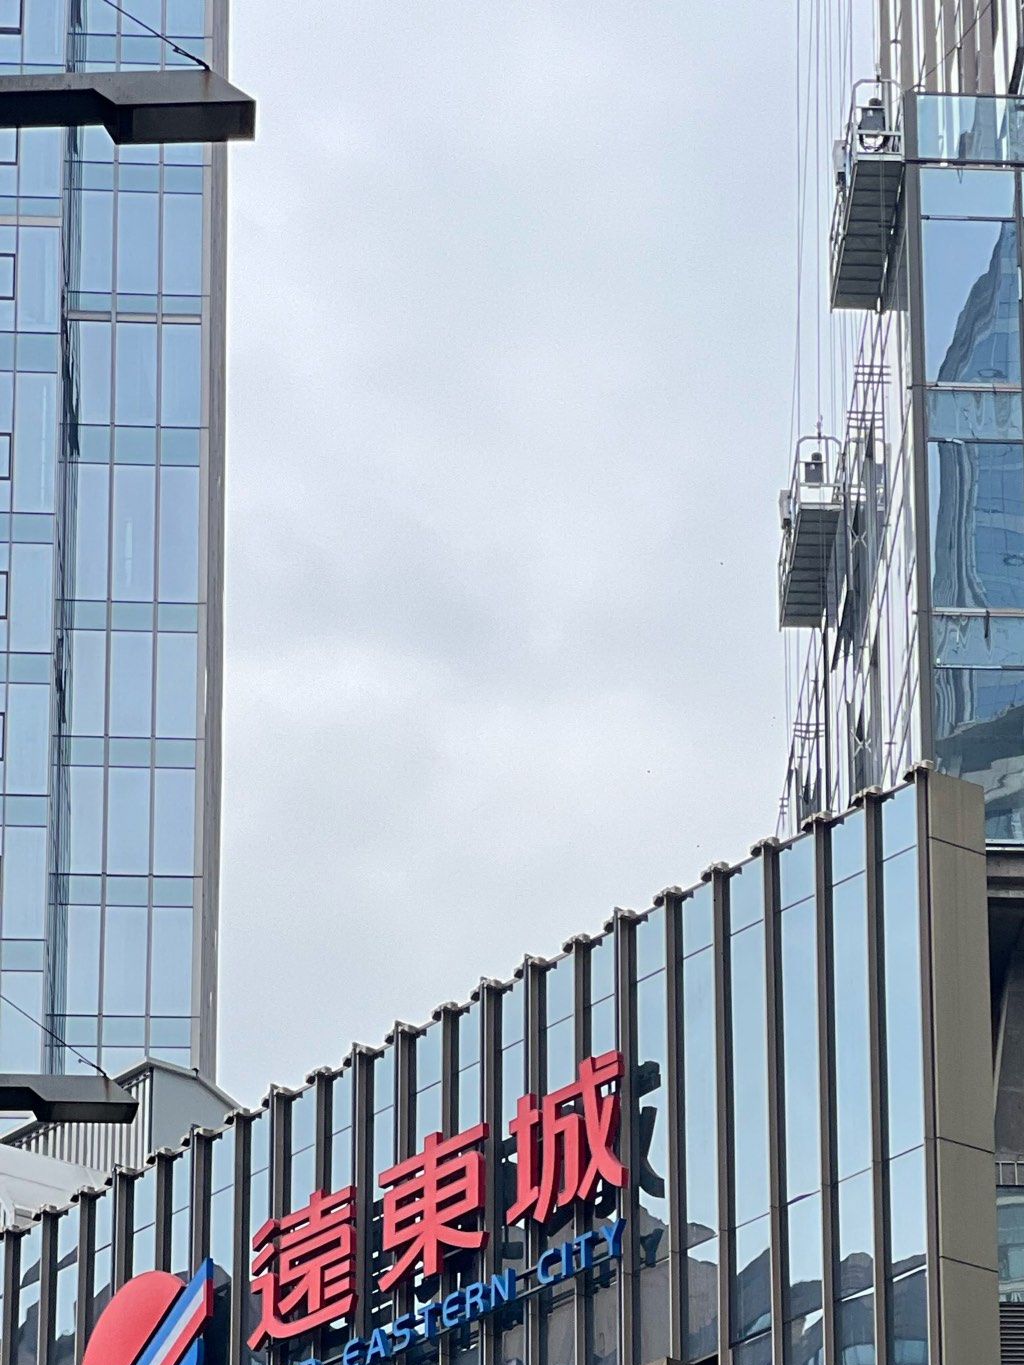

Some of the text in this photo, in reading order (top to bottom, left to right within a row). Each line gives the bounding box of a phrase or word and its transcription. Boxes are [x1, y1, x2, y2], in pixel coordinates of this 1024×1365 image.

[247, 1050, 629, 1351] 遠東城
[537, 1218, 628, 1285] CITY
